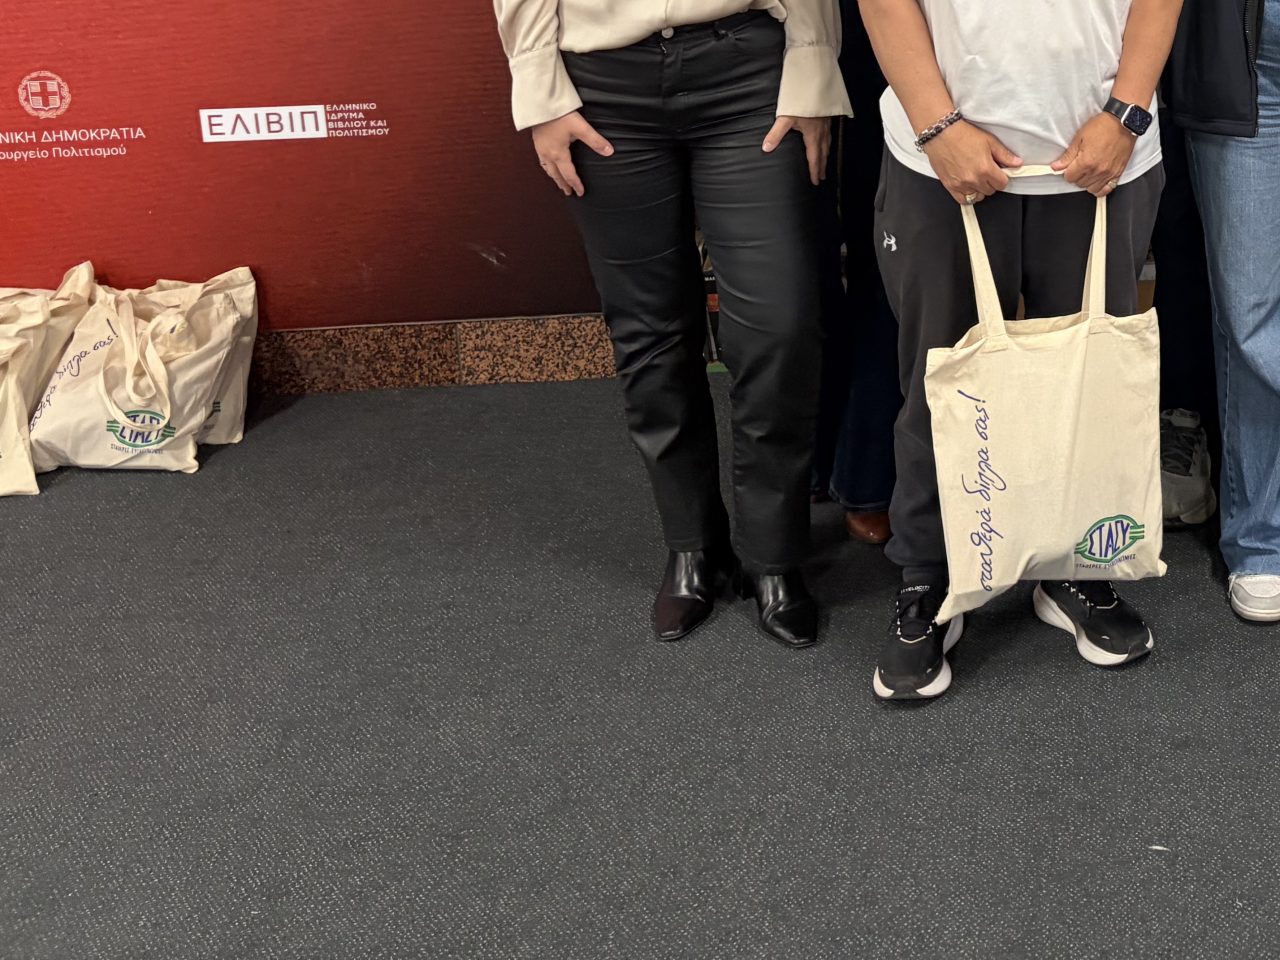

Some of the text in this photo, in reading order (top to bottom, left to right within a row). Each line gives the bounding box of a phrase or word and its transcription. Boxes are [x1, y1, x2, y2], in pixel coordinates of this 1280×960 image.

[326, 103, 377, 111] ΕΛΛΗΝΙΚΟ
[327, 112, 365, 120] ΙΔΡΥΜΑ
[207, 111, 320, 136] ΕΛΙΒΙΠ
[328, 121, 367, 129] ΒΙΒΛΙΟΥ
[41, 128, 146, 143] ΔΗΜΟΚΡΑΤΙΑ
[329, 128, 389, 137] ΠΟΛΙΤΙΣΜΟΥ
[52, 144, 126, 158] Πολιτισμού
[1088, 519, 1131, 559] ΣΤΑΣΥ
